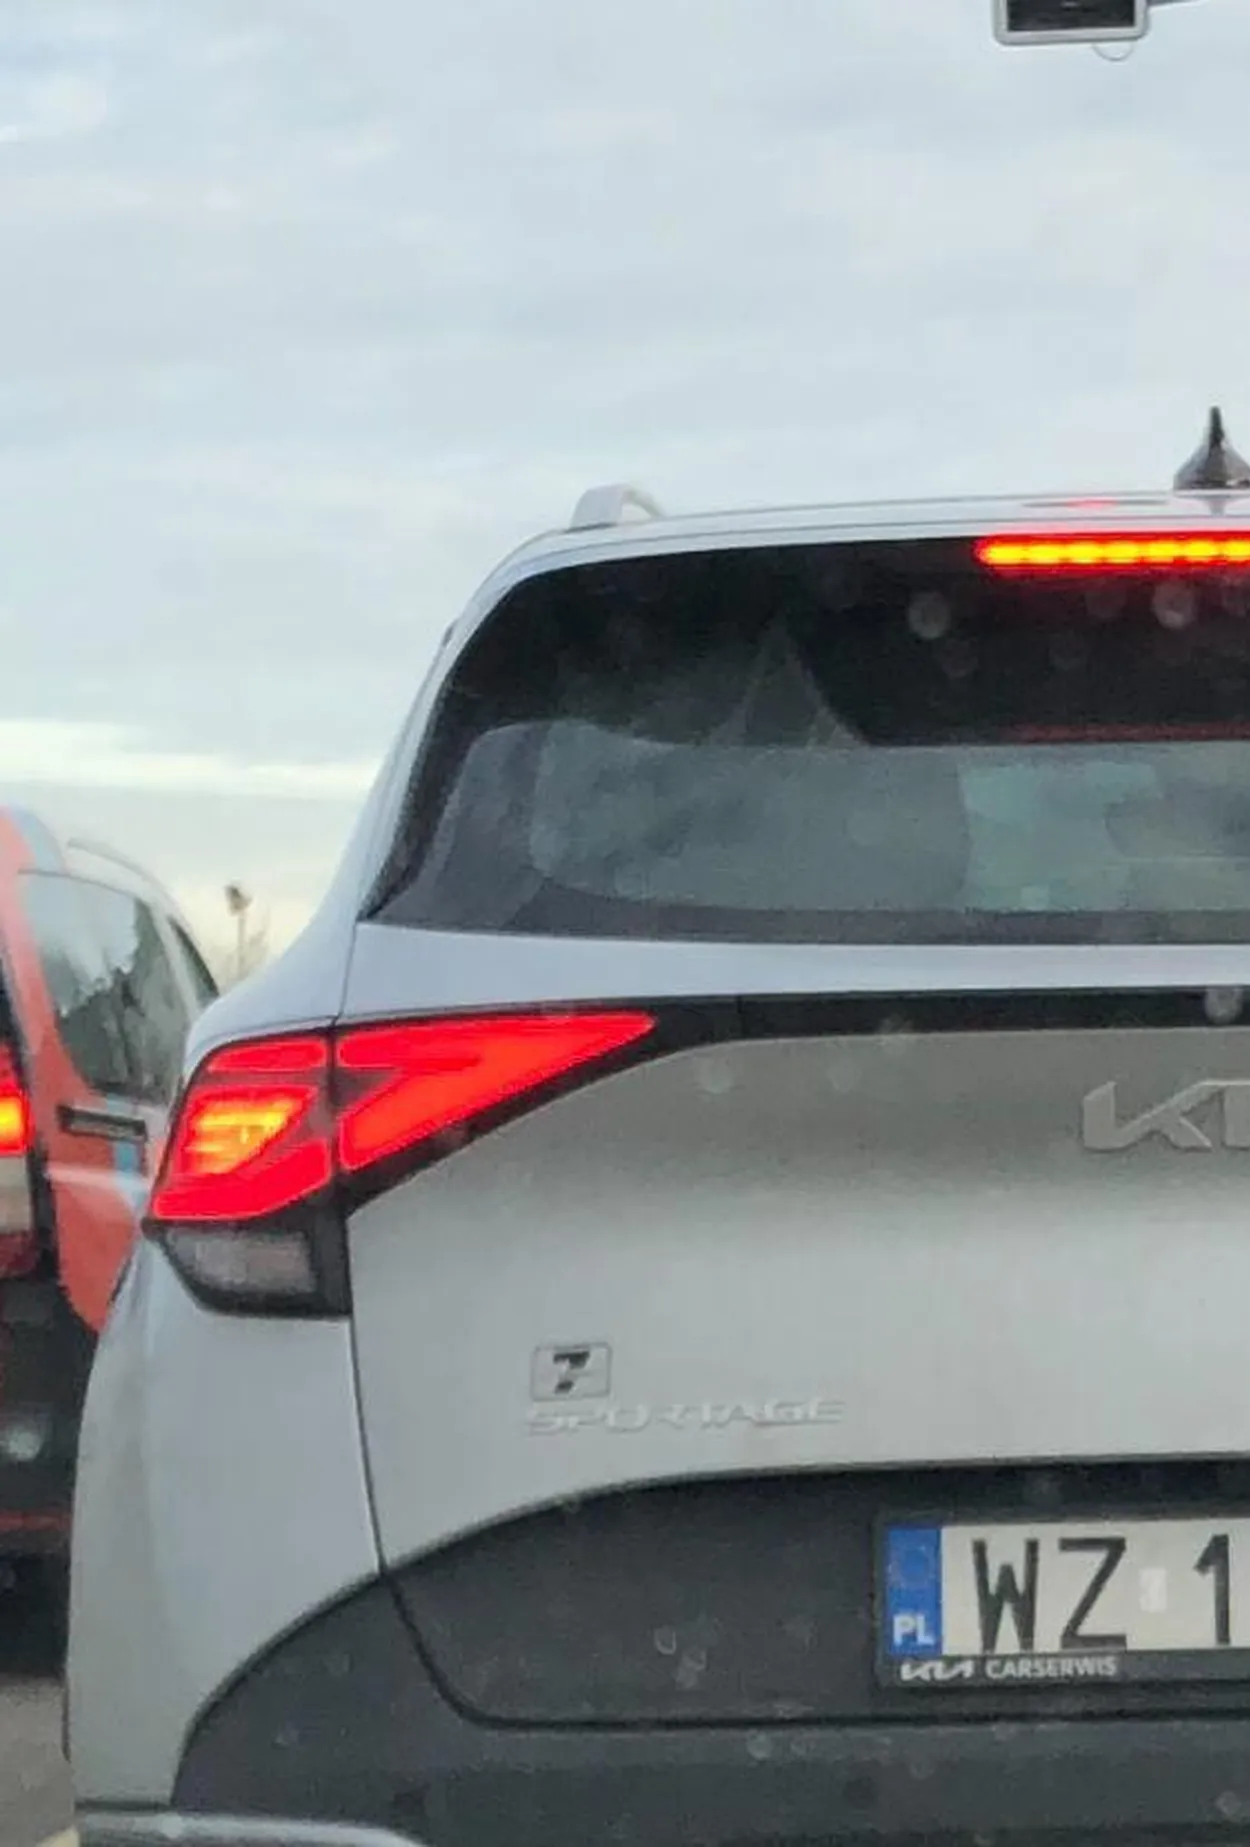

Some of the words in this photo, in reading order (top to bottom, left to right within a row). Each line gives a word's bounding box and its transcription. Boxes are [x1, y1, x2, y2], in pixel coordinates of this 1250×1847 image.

[526, 1397, 845, 1435] SPORTAGE
[972, 1537, 1127, 1652] WZ
[893, 1614, 934, 1645] PL
[900, 1657, 974, 1681] KIA
[985, 1656, 1117, 1680] CARSERWIS
